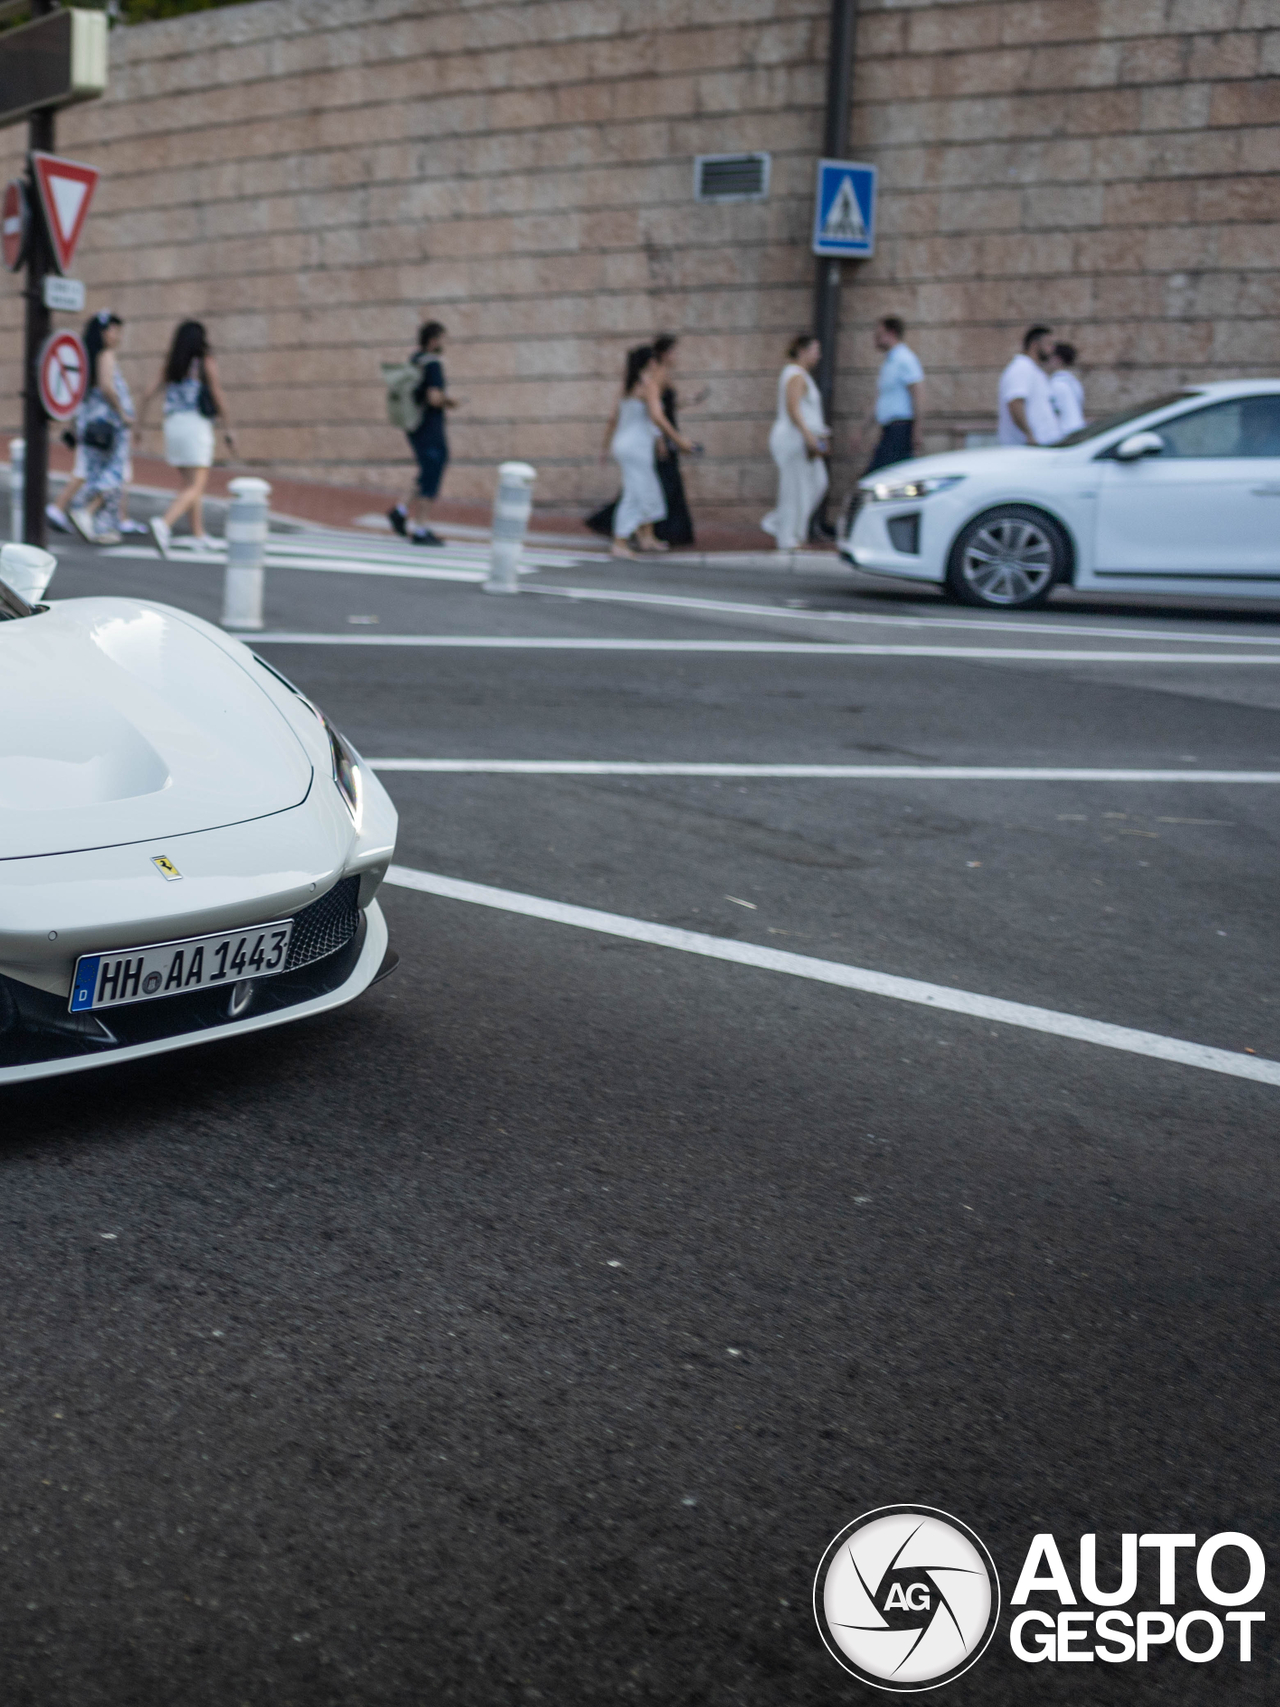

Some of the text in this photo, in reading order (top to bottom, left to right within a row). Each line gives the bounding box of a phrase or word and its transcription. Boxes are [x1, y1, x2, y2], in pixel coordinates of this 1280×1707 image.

[97, 930, 288, 1002] HH AA 1443
[78, 989, 87, 1001] D
